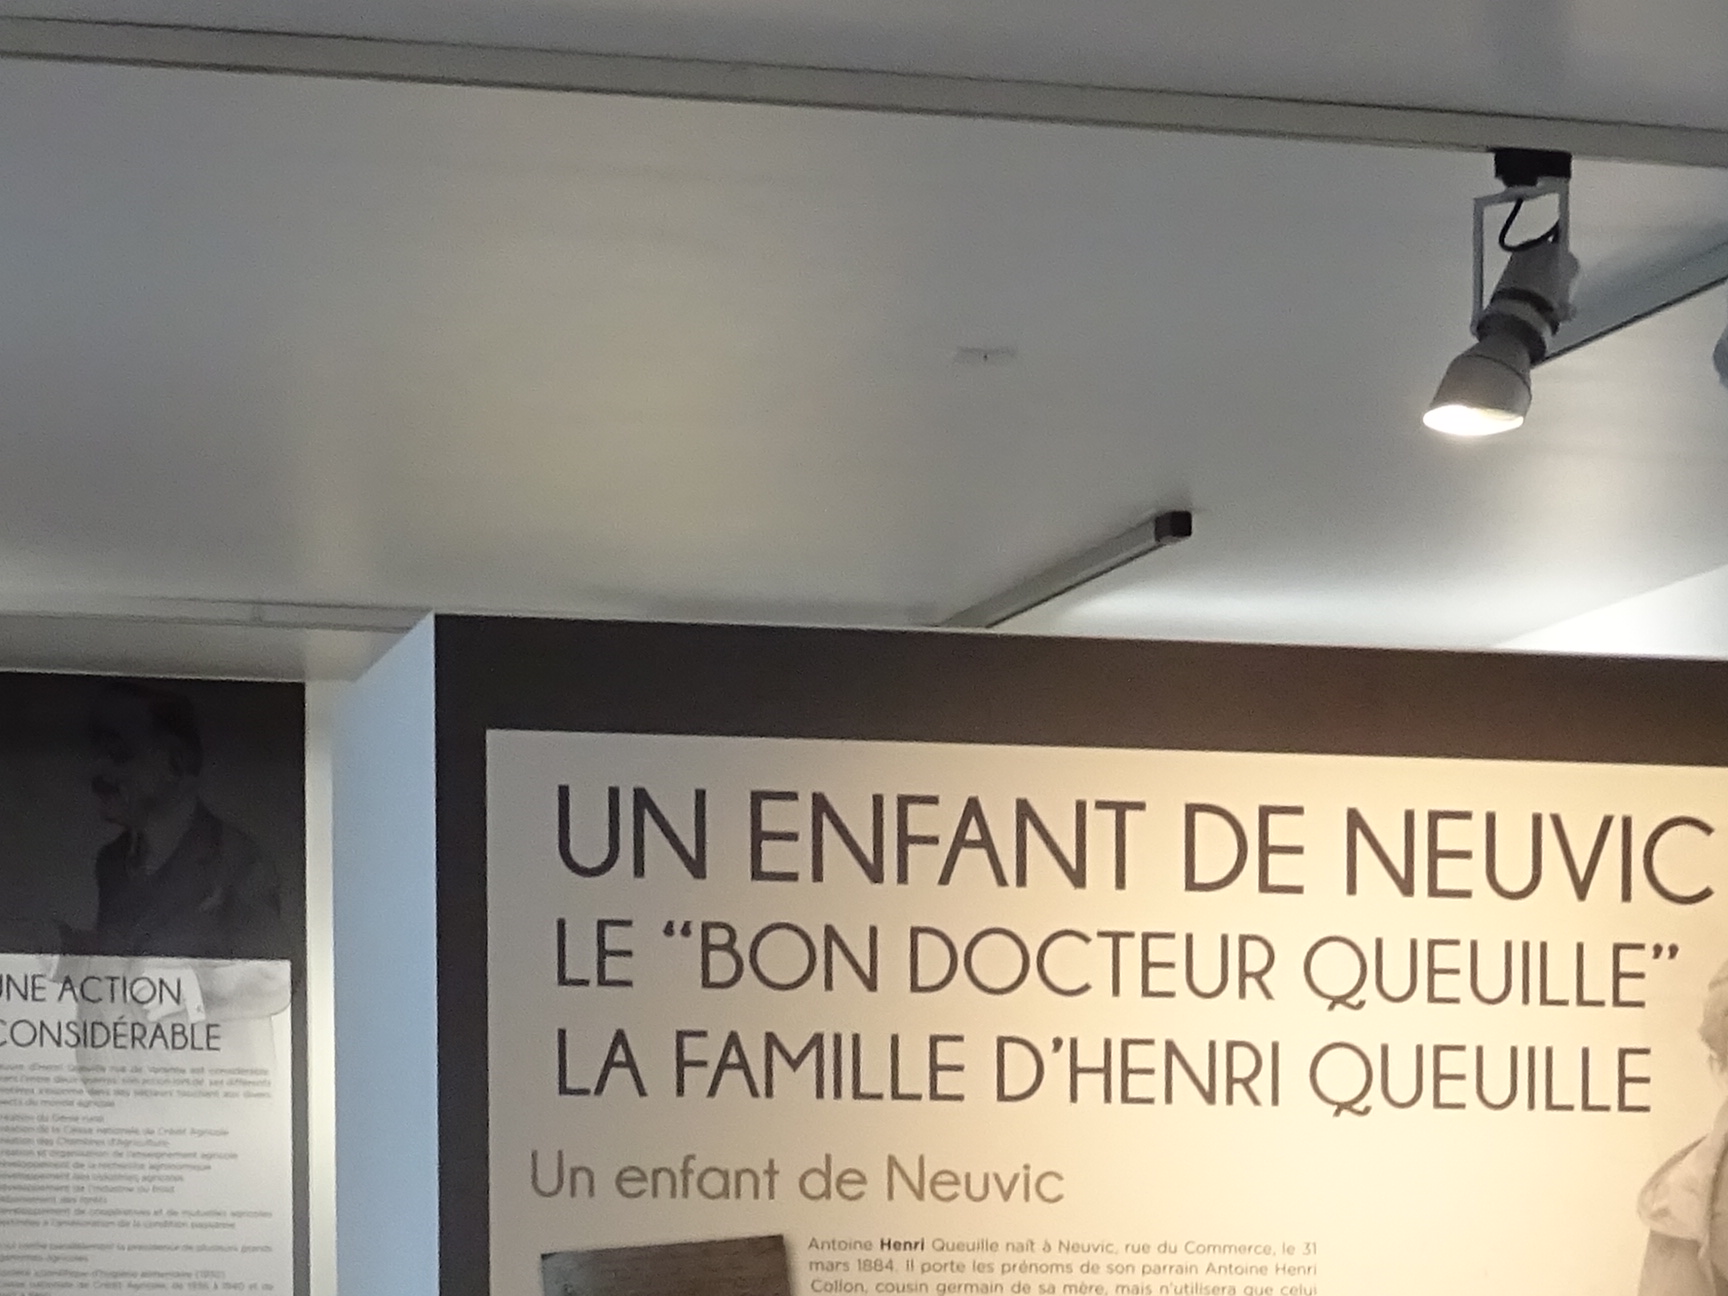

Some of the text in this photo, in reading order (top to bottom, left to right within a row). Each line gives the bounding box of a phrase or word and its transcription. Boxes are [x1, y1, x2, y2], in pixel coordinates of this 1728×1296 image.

[557, 784, 1715, 906] UN ENFANT DE NEUVIC
[556, 917, 1680, 1011] LE “BON DOCTEUR QUEUILLE”
[57, 974, 183, 1007] ACTION
[557, 1027, 1652, 1118] LA FAMILLE D'HENRI QUEUILLE
[530, 1149, 1065, 1205] Un enfant de Neuvic
[807, 1236, 874, 1252] Antoine
[879, 1236, 926, 1253] Henri
[931, 1237, 1000, 1253] Queuille
[1005, 1238, 1036, 1254] naît
[1041, 1239, 1052, 1254] à
[1124, 1242, 1151, 1254] rue
[1156, 1240, 1178, 1255] du
[1282, 1242, 1296, 1256] le
[1302, 1241, 1317, 1256] 31
[808, 1260, 850, 1273] mars
[905, 1257, 915, 1273] Il
[920, 1259, 966, 1276] porte
[971, 1258, 995, 1274] les
[1000, 1259, 1074, 1277] prénoms
[1079, 1259, 1101, 1275] de
[1105, 1262, 1136, 1275] son
[1141, 1263, 1199, 1278] parrain
[1205, 1261, 1269, 1277] Antoine
[1274, 1263, 1317, 1277] Henri
[874, 1282, 929, 1295] cousin
[1010, 1280, 1032, 1295] de
[1038, 1283, 1057, 1296] sa
[1114, 1283, 1153, 1296] mais
[1279, 1283, 1318, 1296] celui
